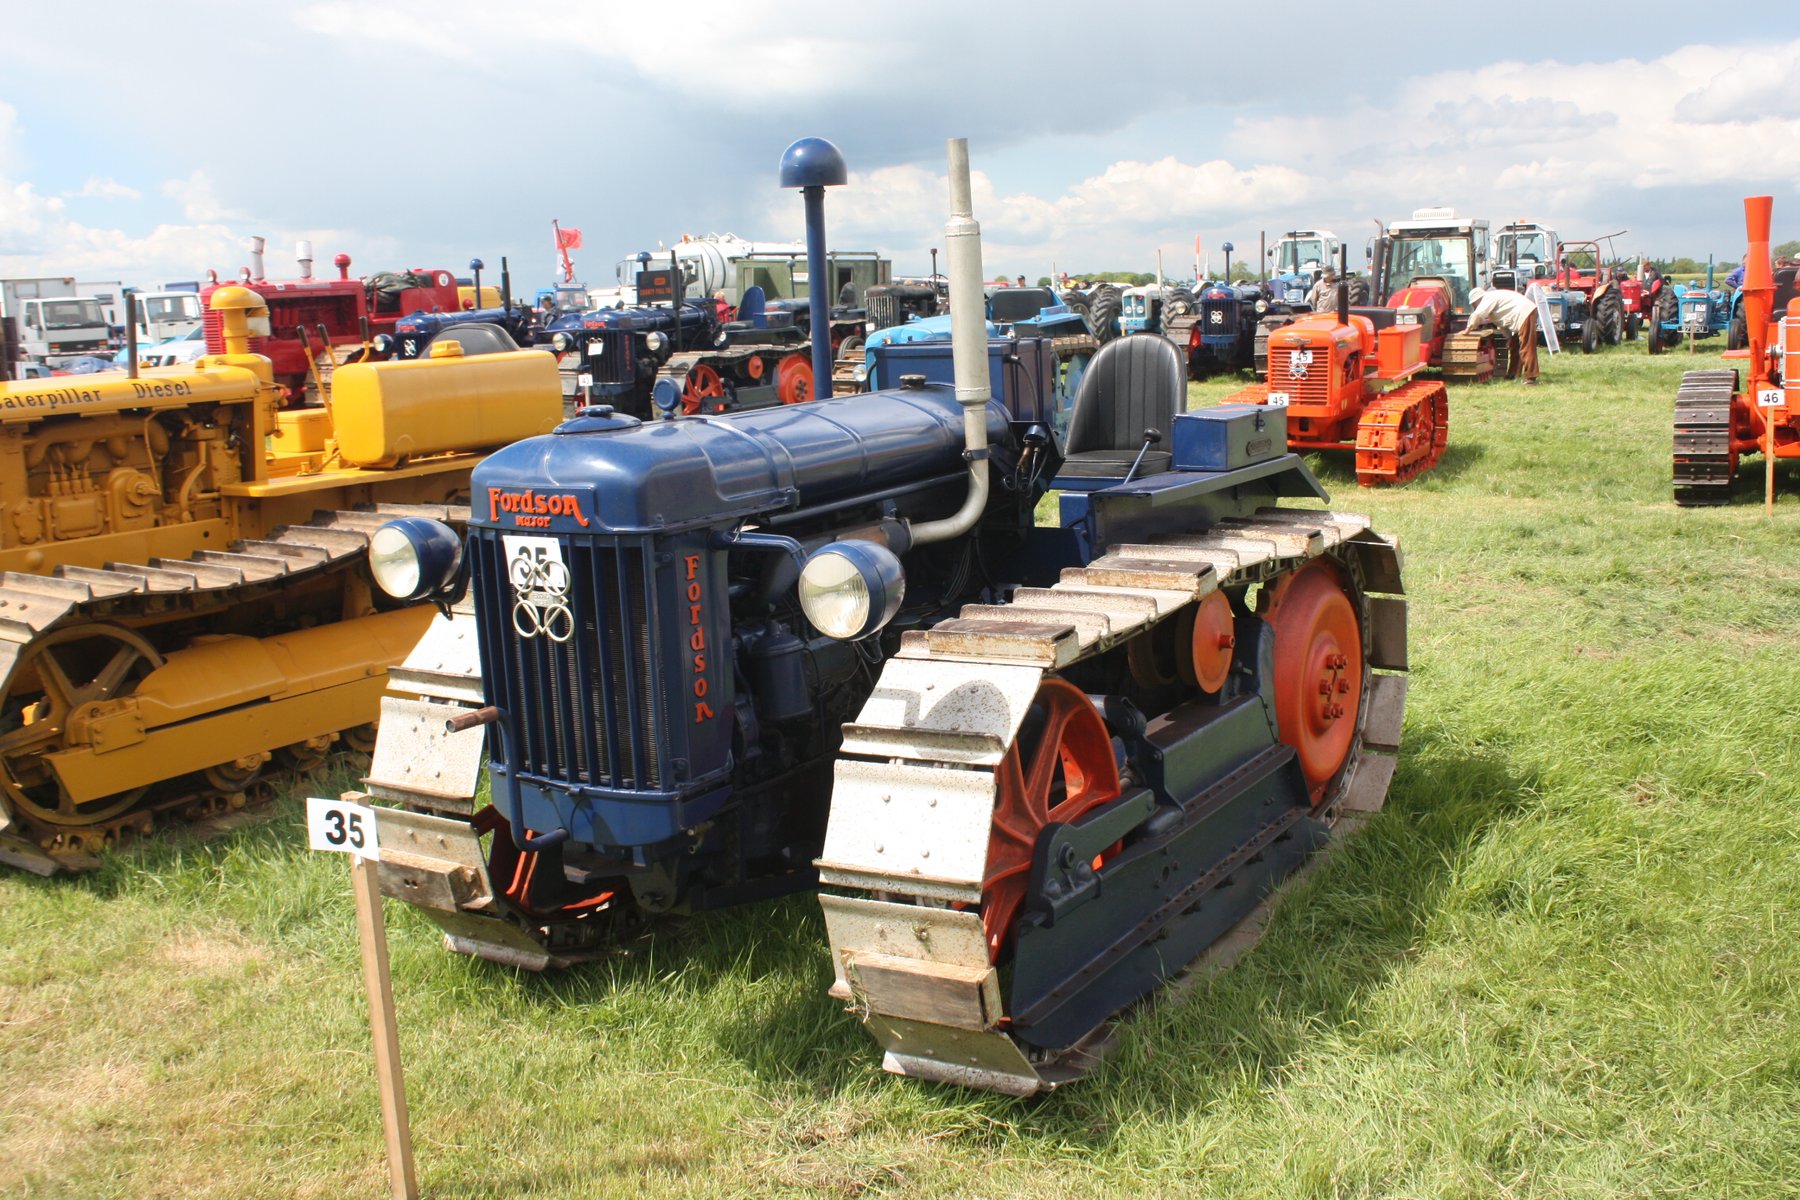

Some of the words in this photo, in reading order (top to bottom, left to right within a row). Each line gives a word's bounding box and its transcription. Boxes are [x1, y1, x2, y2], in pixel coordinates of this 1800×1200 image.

[0, 388, 101, 409] aterpillar
[132, 381, 193, 399] Diesel
[1273, 396, 1285, 406] 45
[1764, 392, 1779, 404] 46
[488, 487, 590, 527] Fordson
[518, 546, 551, 580] 35
[683, 555, 714, 723] Fordson
[325, 809, 365, 849] 35
